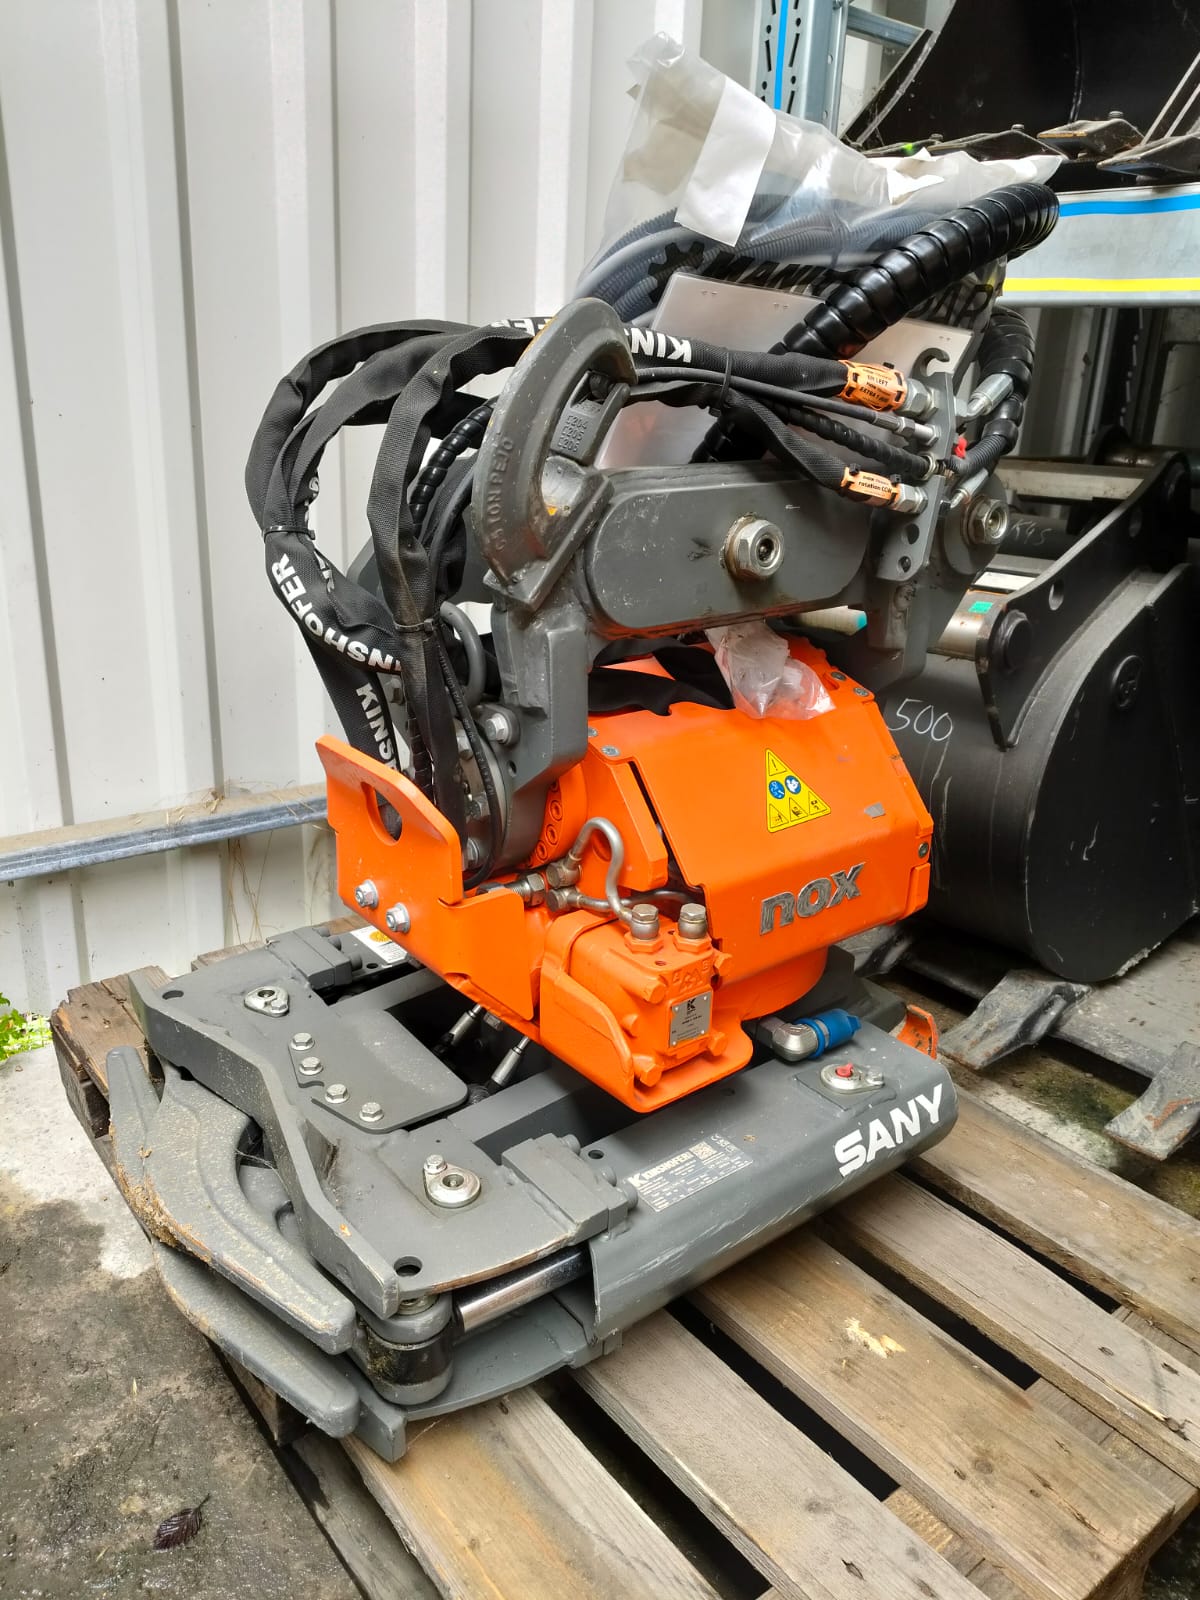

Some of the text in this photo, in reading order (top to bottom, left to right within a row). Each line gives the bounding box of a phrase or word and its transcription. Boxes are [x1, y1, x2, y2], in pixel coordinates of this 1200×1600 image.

[624, 328, 692, 363] KIN
[271, 553, 402, 673] INSHOFER
[886, 698, 953, 741] 500
[760, 862, 866, 936] nox
[834, 1083, 942, 1178] SANY
